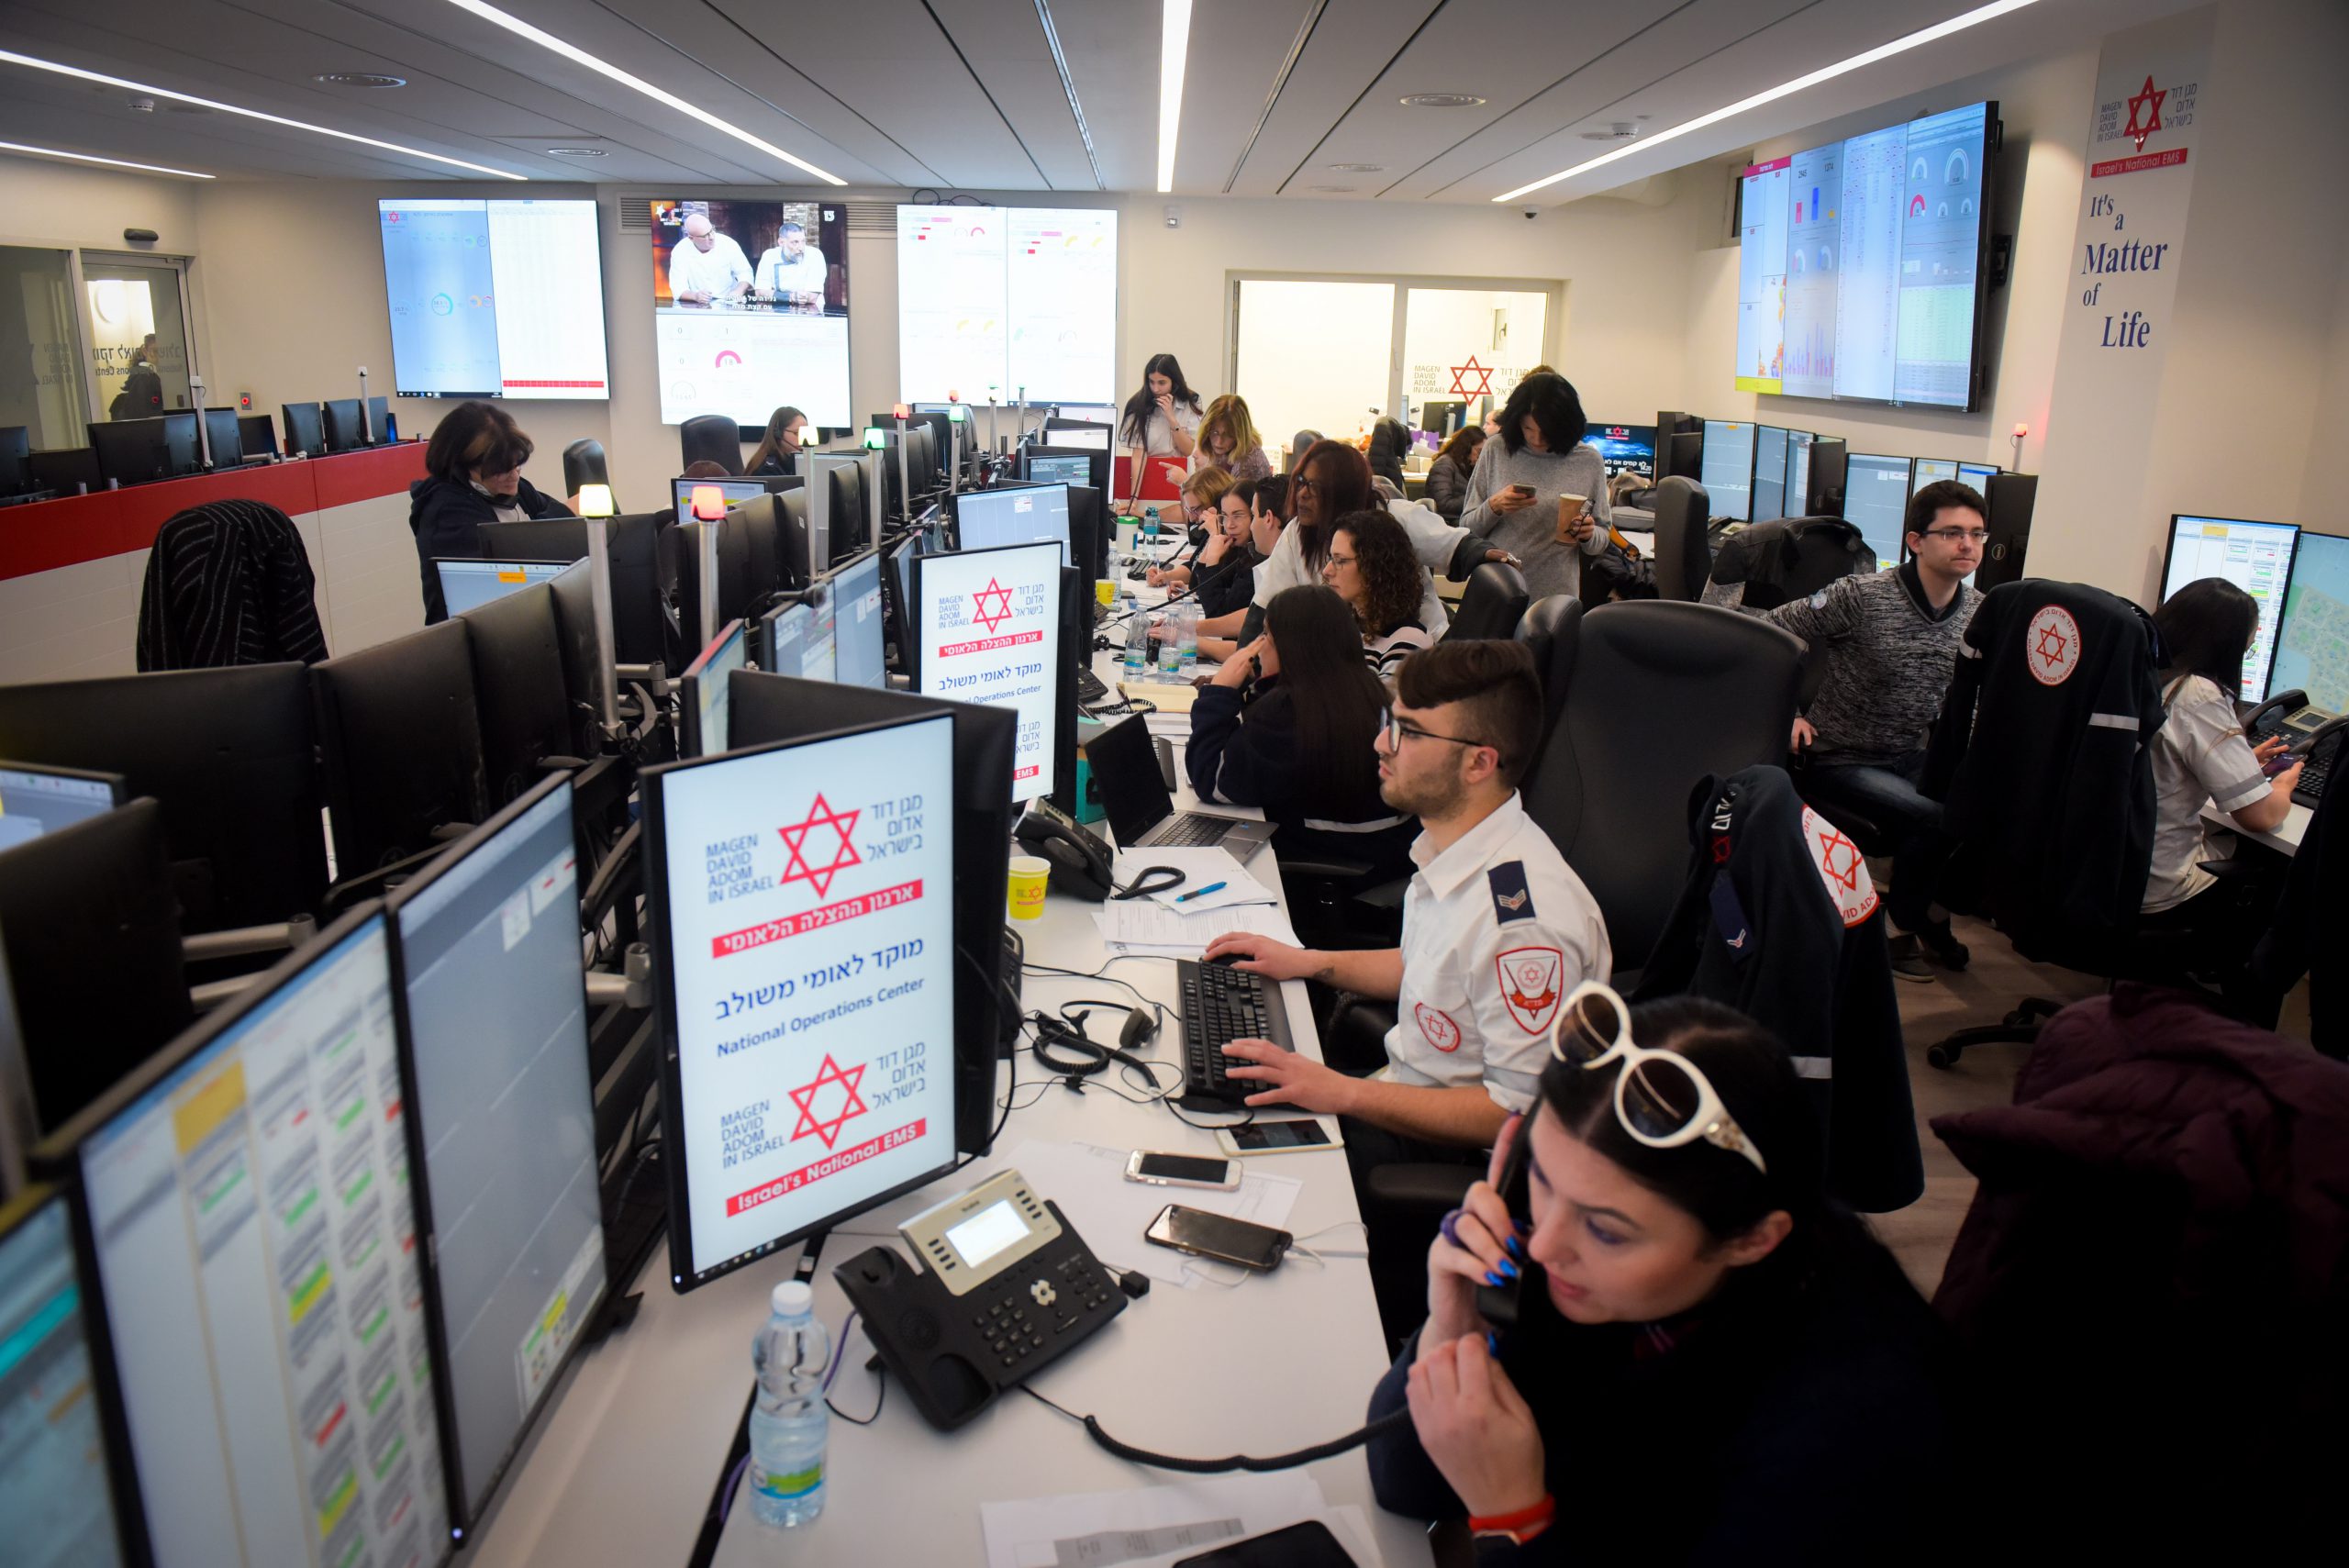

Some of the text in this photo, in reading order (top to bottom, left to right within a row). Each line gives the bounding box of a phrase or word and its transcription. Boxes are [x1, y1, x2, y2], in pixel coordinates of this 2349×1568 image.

[2171, 83, 2197, 99] מגן דוד
[2101, 101, 2122, 113] MAGEN
[2176, 97, 2195, 113] אדום
[2099, 111, 2118, 123] DAVID
[2099, 121, 2117, 133] ADOM
[2165, 113, 2193, 129] בישראל
[2105, 129, 2123, 141] ISRAEL
[2096, 151, 2180, 176] Israel's National EMS
[2090, 194, 2114, 217] It's
[2114, 213, 2124, 230] a
[2081, 238, 2168, 275] Matter
[2083, 282, 2101, 306] of
[2100, 310, 2151, 348] Life
[939, 595, 963, 605] MAGEN
[1018, 584, 1044, 595] מגן דוד
[1026, 595, 1043, 606] אדום
[939, 604, 960, 613] DAVID
[939, 611, 960, 620] ADOM
[1015, 605, 1043, 617] בישראל
[948, 617, 969, 628] ISRAEL
[944, 632, 1038, 655] ארגון ההצלה הלאומי
[939, 662, 1042, 691] מוקד לאומי משולב
[974, 689, 1015, 705] Operations
[1017, 685, 1041, 695] Center
[1023, 731, 1040, 742] אדום
[1030, 721, 1041, 732] מגן
[1016, 741, 1040, 754] בישרא
[1017, 767, 1034, 779] EMS
[871, 795, 923, 819] מגן דוד
[887, 814, 923, 837] אדום
[706, 833, 758, 858] MAGEN
[867, 834, 922, 862] בישראל
[707, 851, 751, 873] DAVID
[708, 865, 752, 888] ADOM
[708, 875, 774, 904] IN ISRAEL
[1861, 890, 1875, 912] ADO
[723, 885, 914, 951] ארגון ההצלה הלאומי
[715, 938, 924, 1019] מוקד לאומי משולב
[718, 977, 925, 1057] National Operations Center
[875, 1041, 926, 1070] מגן דוד
[892, 1059, 926, 1084] אדום
[872, 1077, 926, 1109] בישראל
[720, 1099, 769, 1128] MAGEN
[722, 1116, 763, 1141] DAVID
[723, 1129, 764, 1155] ADOM
[723, 1135, 785, 1170] IN ISRAEL
[738, 1124, 917, 1211] Israel's National EMS
